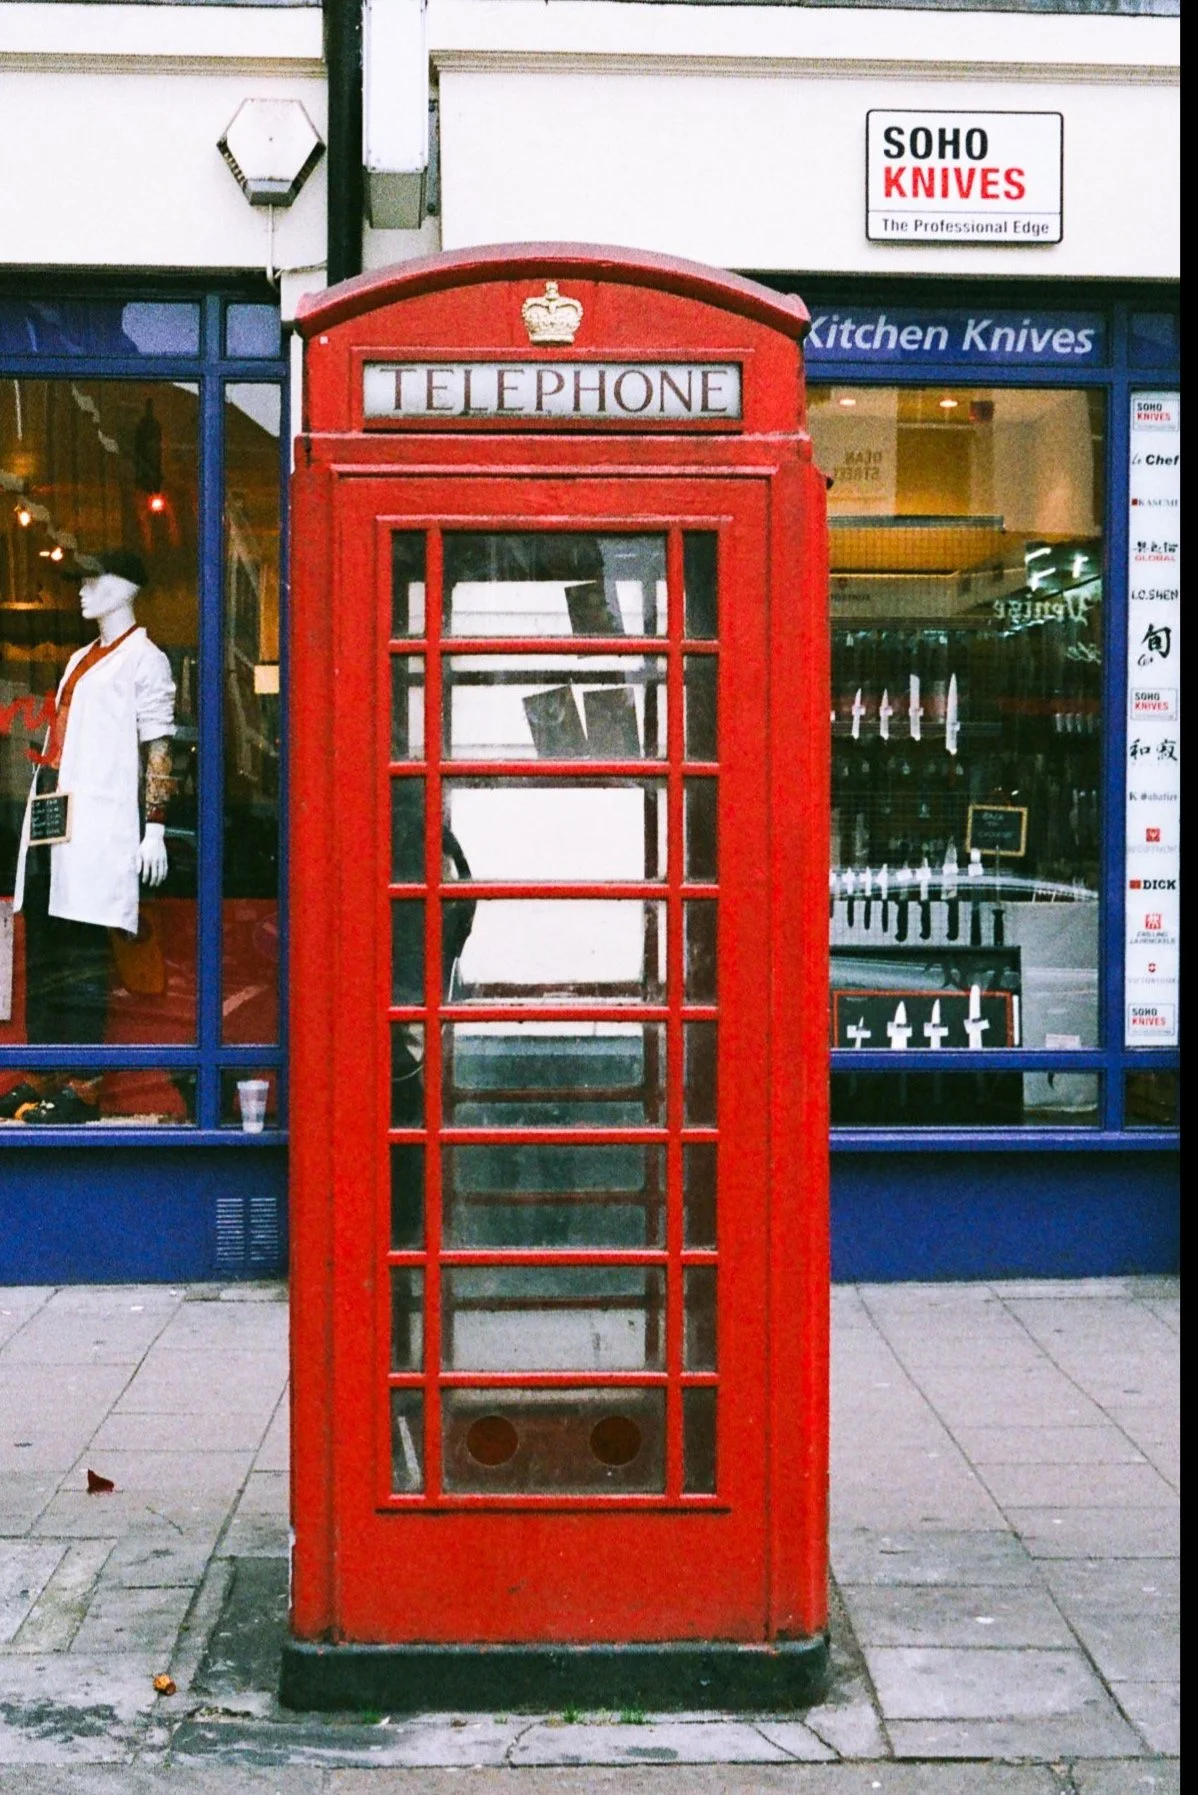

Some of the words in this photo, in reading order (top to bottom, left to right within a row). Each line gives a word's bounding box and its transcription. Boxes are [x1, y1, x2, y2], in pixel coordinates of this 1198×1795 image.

[883, 126, 989, 161] SOHO
[883, 166, 1026, 200] KNIVES
[882, 218, 908, 233] The
[914, 218, 1008, 236] Professional
[1013, 220, 1049, 237] Edge
[804, 314, 949, 352] Kitchen
[962, 318, 1095, 355] Knives
[379, 367, 729, 414] TELEPHONE
[1137, 402, 1162, 412] SOHO
[1137, 411, 1171, 421] KNIVES
[1145, 454, 1179, 466] Chef
[1134, 691, 1160, 701] SOHO
[1134, 701, 1169, 711] KNIVES
[1143, 879, 1177, 890] DICK
[1132, 1007, 1158, 1017] SOHO
[1131, 1017, 1166, 1026] KNIVES
